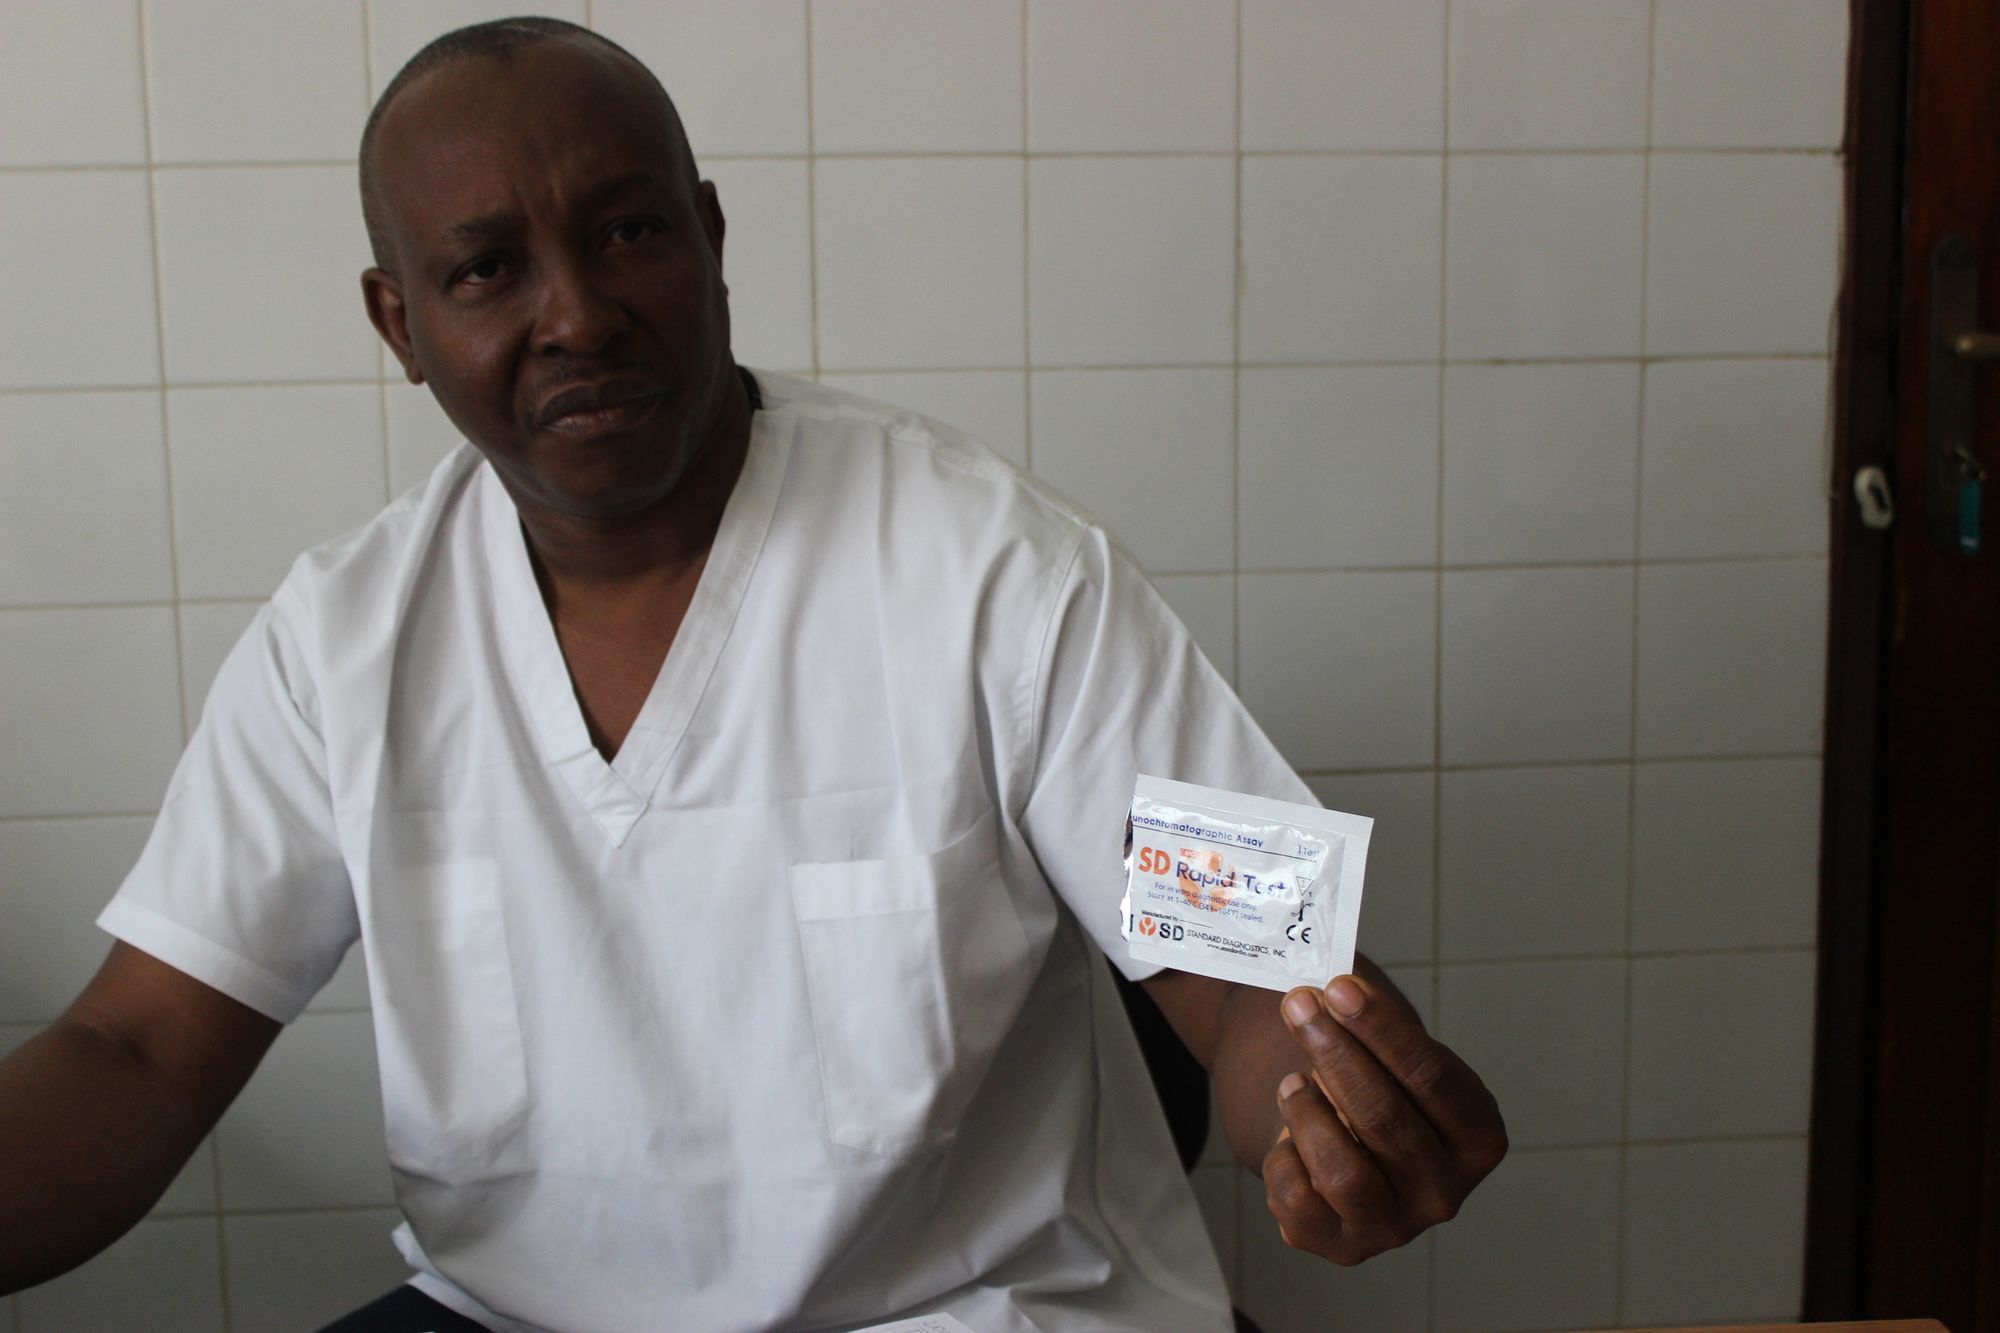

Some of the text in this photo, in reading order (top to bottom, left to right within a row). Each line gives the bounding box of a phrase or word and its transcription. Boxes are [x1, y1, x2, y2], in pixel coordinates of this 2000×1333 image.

[1235, 834, 1264, 847] Assay
[1138, 846, 1286, 896] SD Rapid Test
[1147, 891, 1165, 901] Store
[1166, 895, 1174, 903] at
[1154, 882, 1166, 890] For
[1175, 886, 1191, 897] vitro
[1191, 892, 1226, 905] diagnostic
[1228, 899, 1240, 908] use
[1141, 909, 1172, 920] Manufactured
[1159, 922, 1184, 942] SD
[1187, 929, 1222, 944] STANDARD
